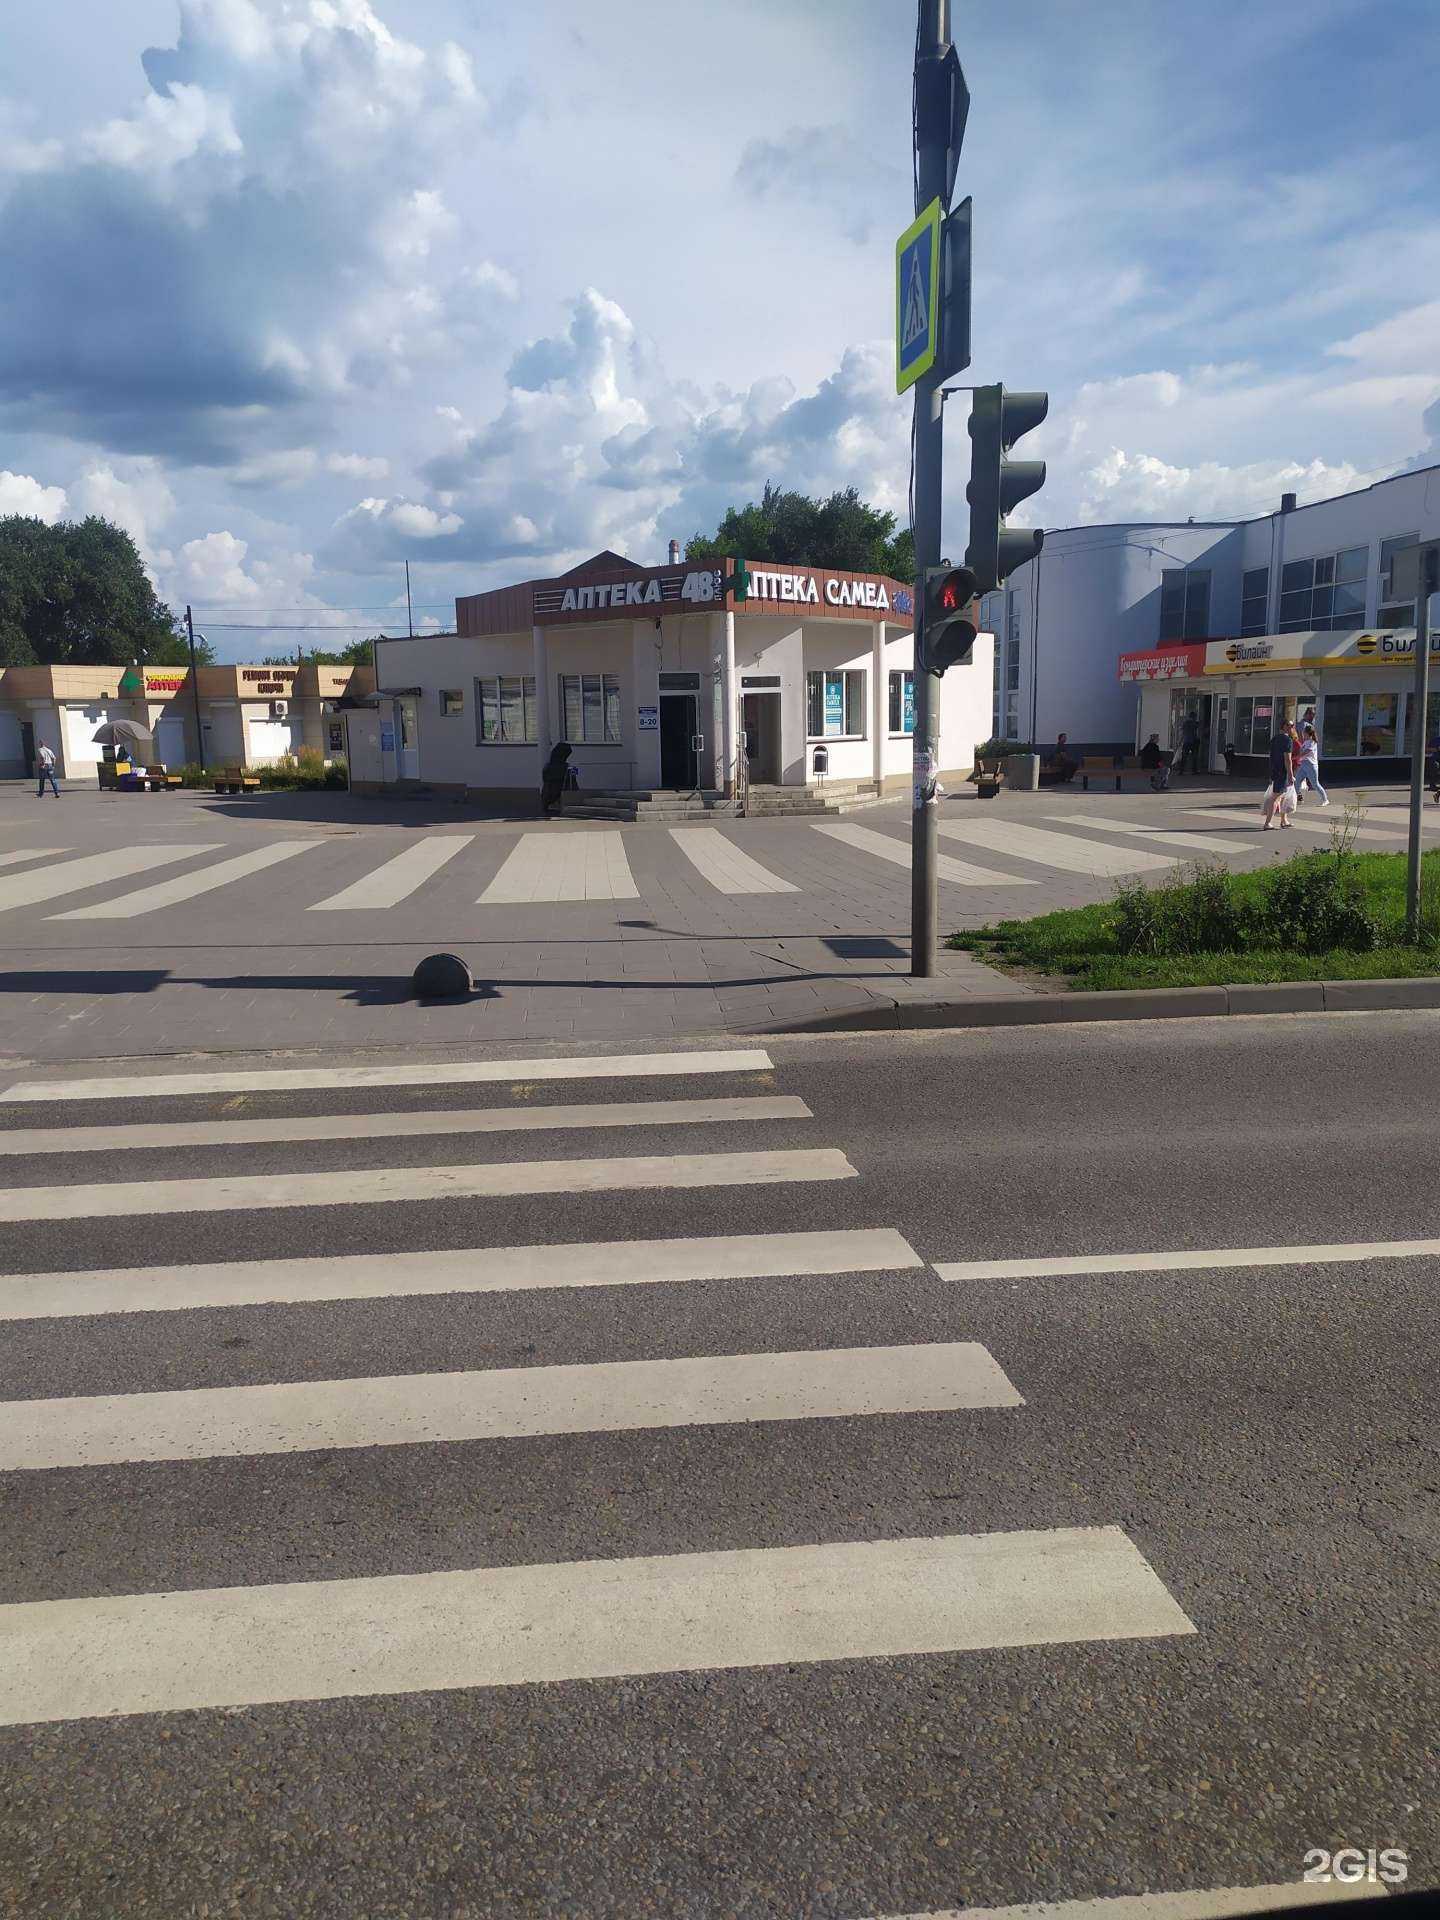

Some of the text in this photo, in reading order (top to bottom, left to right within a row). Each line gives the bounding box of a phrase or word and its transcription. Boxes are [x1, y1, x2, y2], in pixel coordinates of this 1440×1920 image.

[561, 571, 714, 611] АПТЕКА 48
[825, 579, 890, 610] САМЕД
